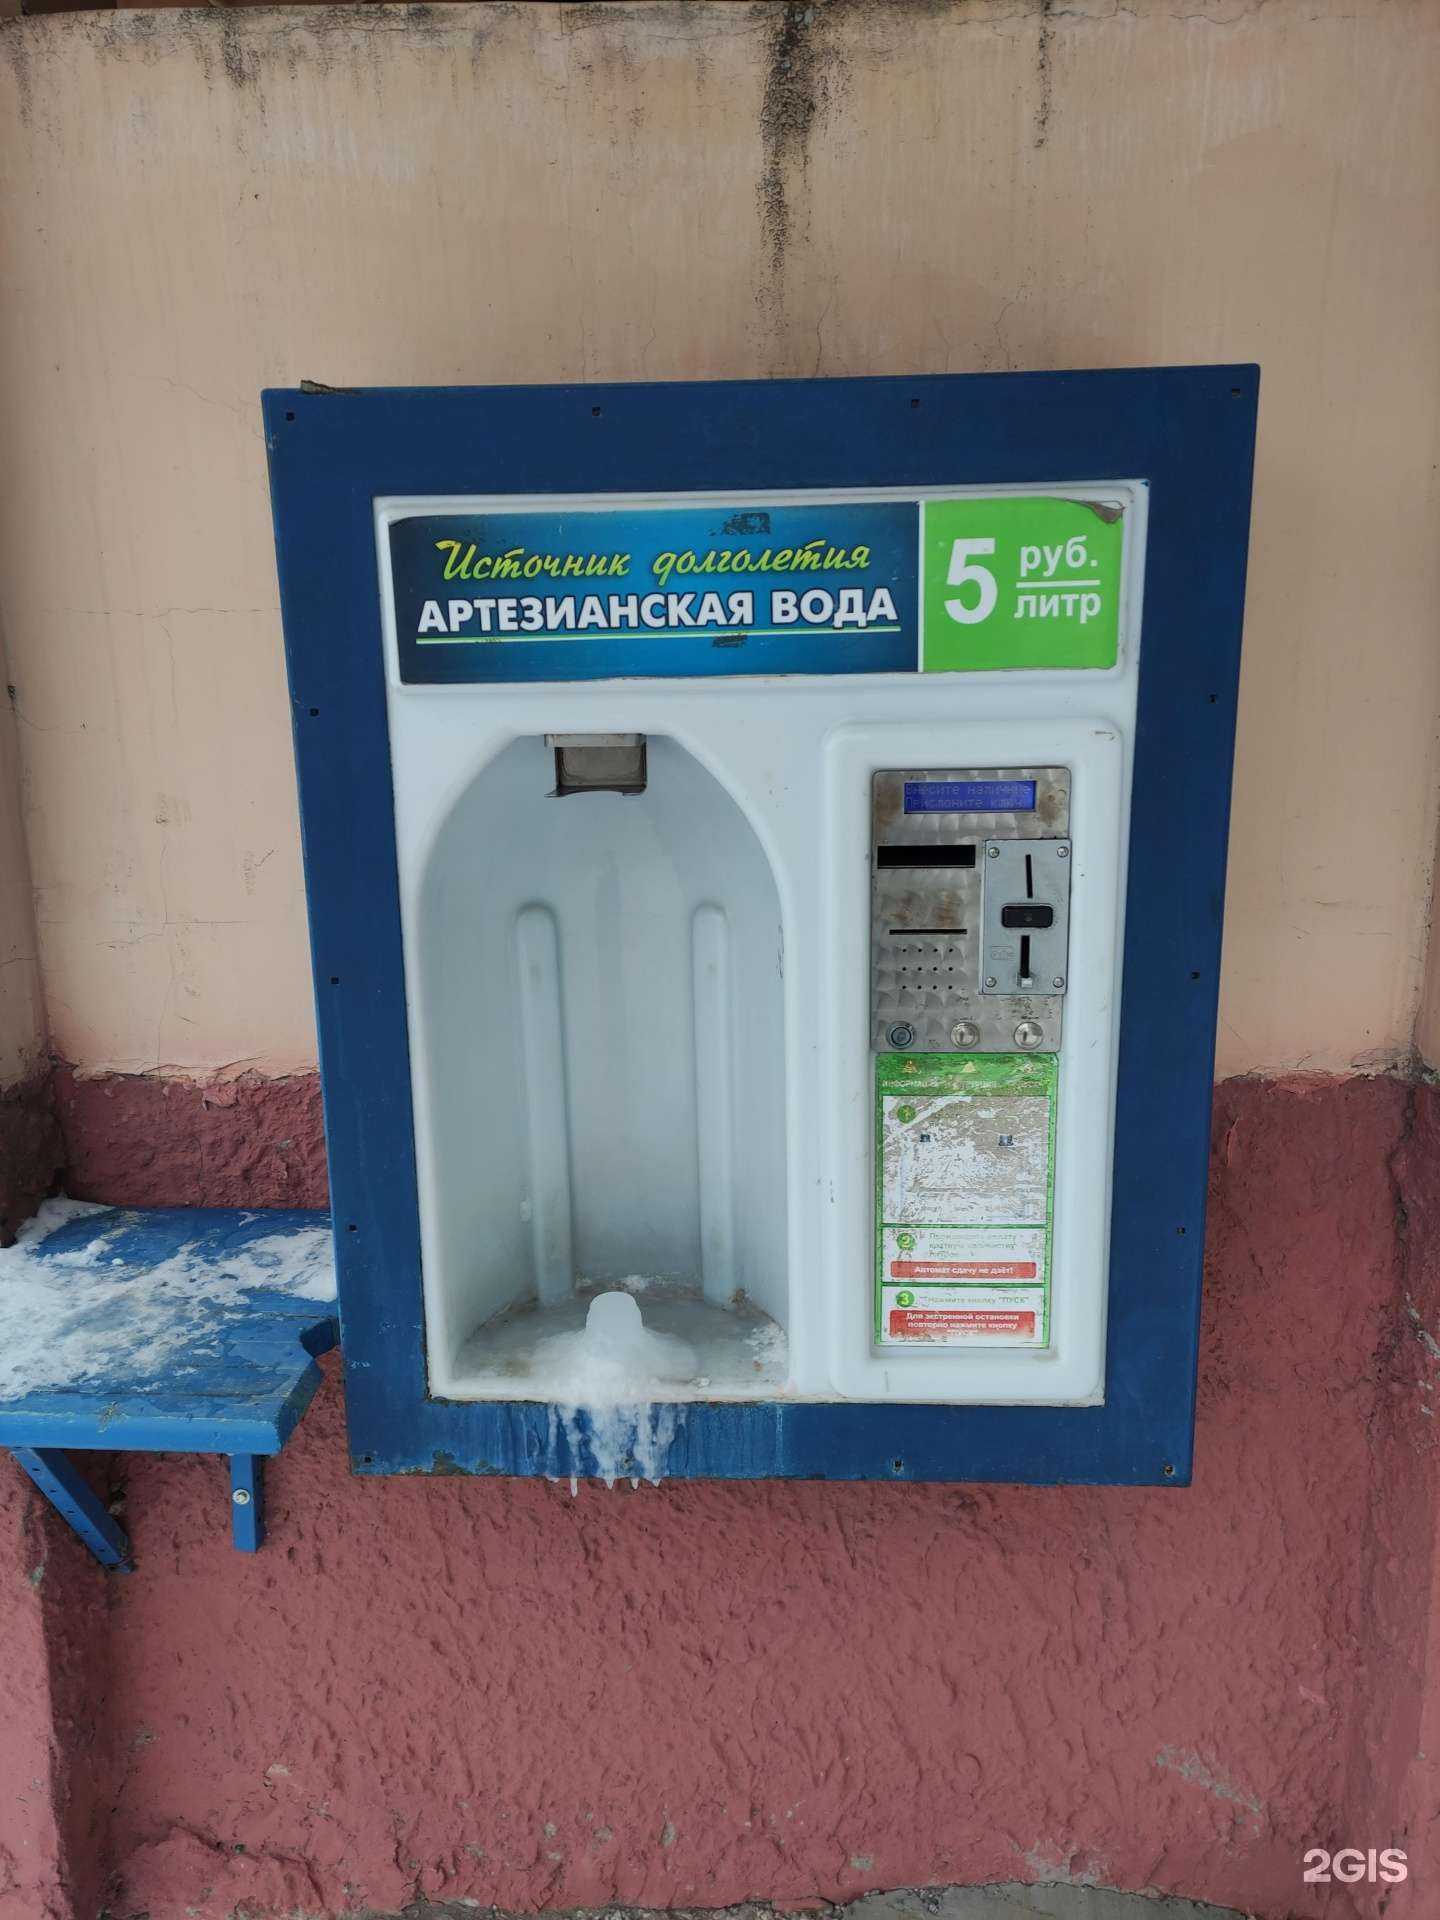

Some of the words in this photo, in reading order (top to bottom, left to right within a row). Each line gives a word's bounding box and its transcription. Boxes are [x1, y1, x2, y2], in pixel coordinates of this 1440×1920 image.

[434, 539, 631, 582] Источник
[652, 538, 872, 587] долголетия
[1019, 535, 1099, 577] руб.
[943, 537, 998, 625] 5
[417, 592, 754, 633] АРТЕЗИАНСКАЯ
[771, 587, 899, 628] ВОДА
[1014, 591, 1102, 624] литр
